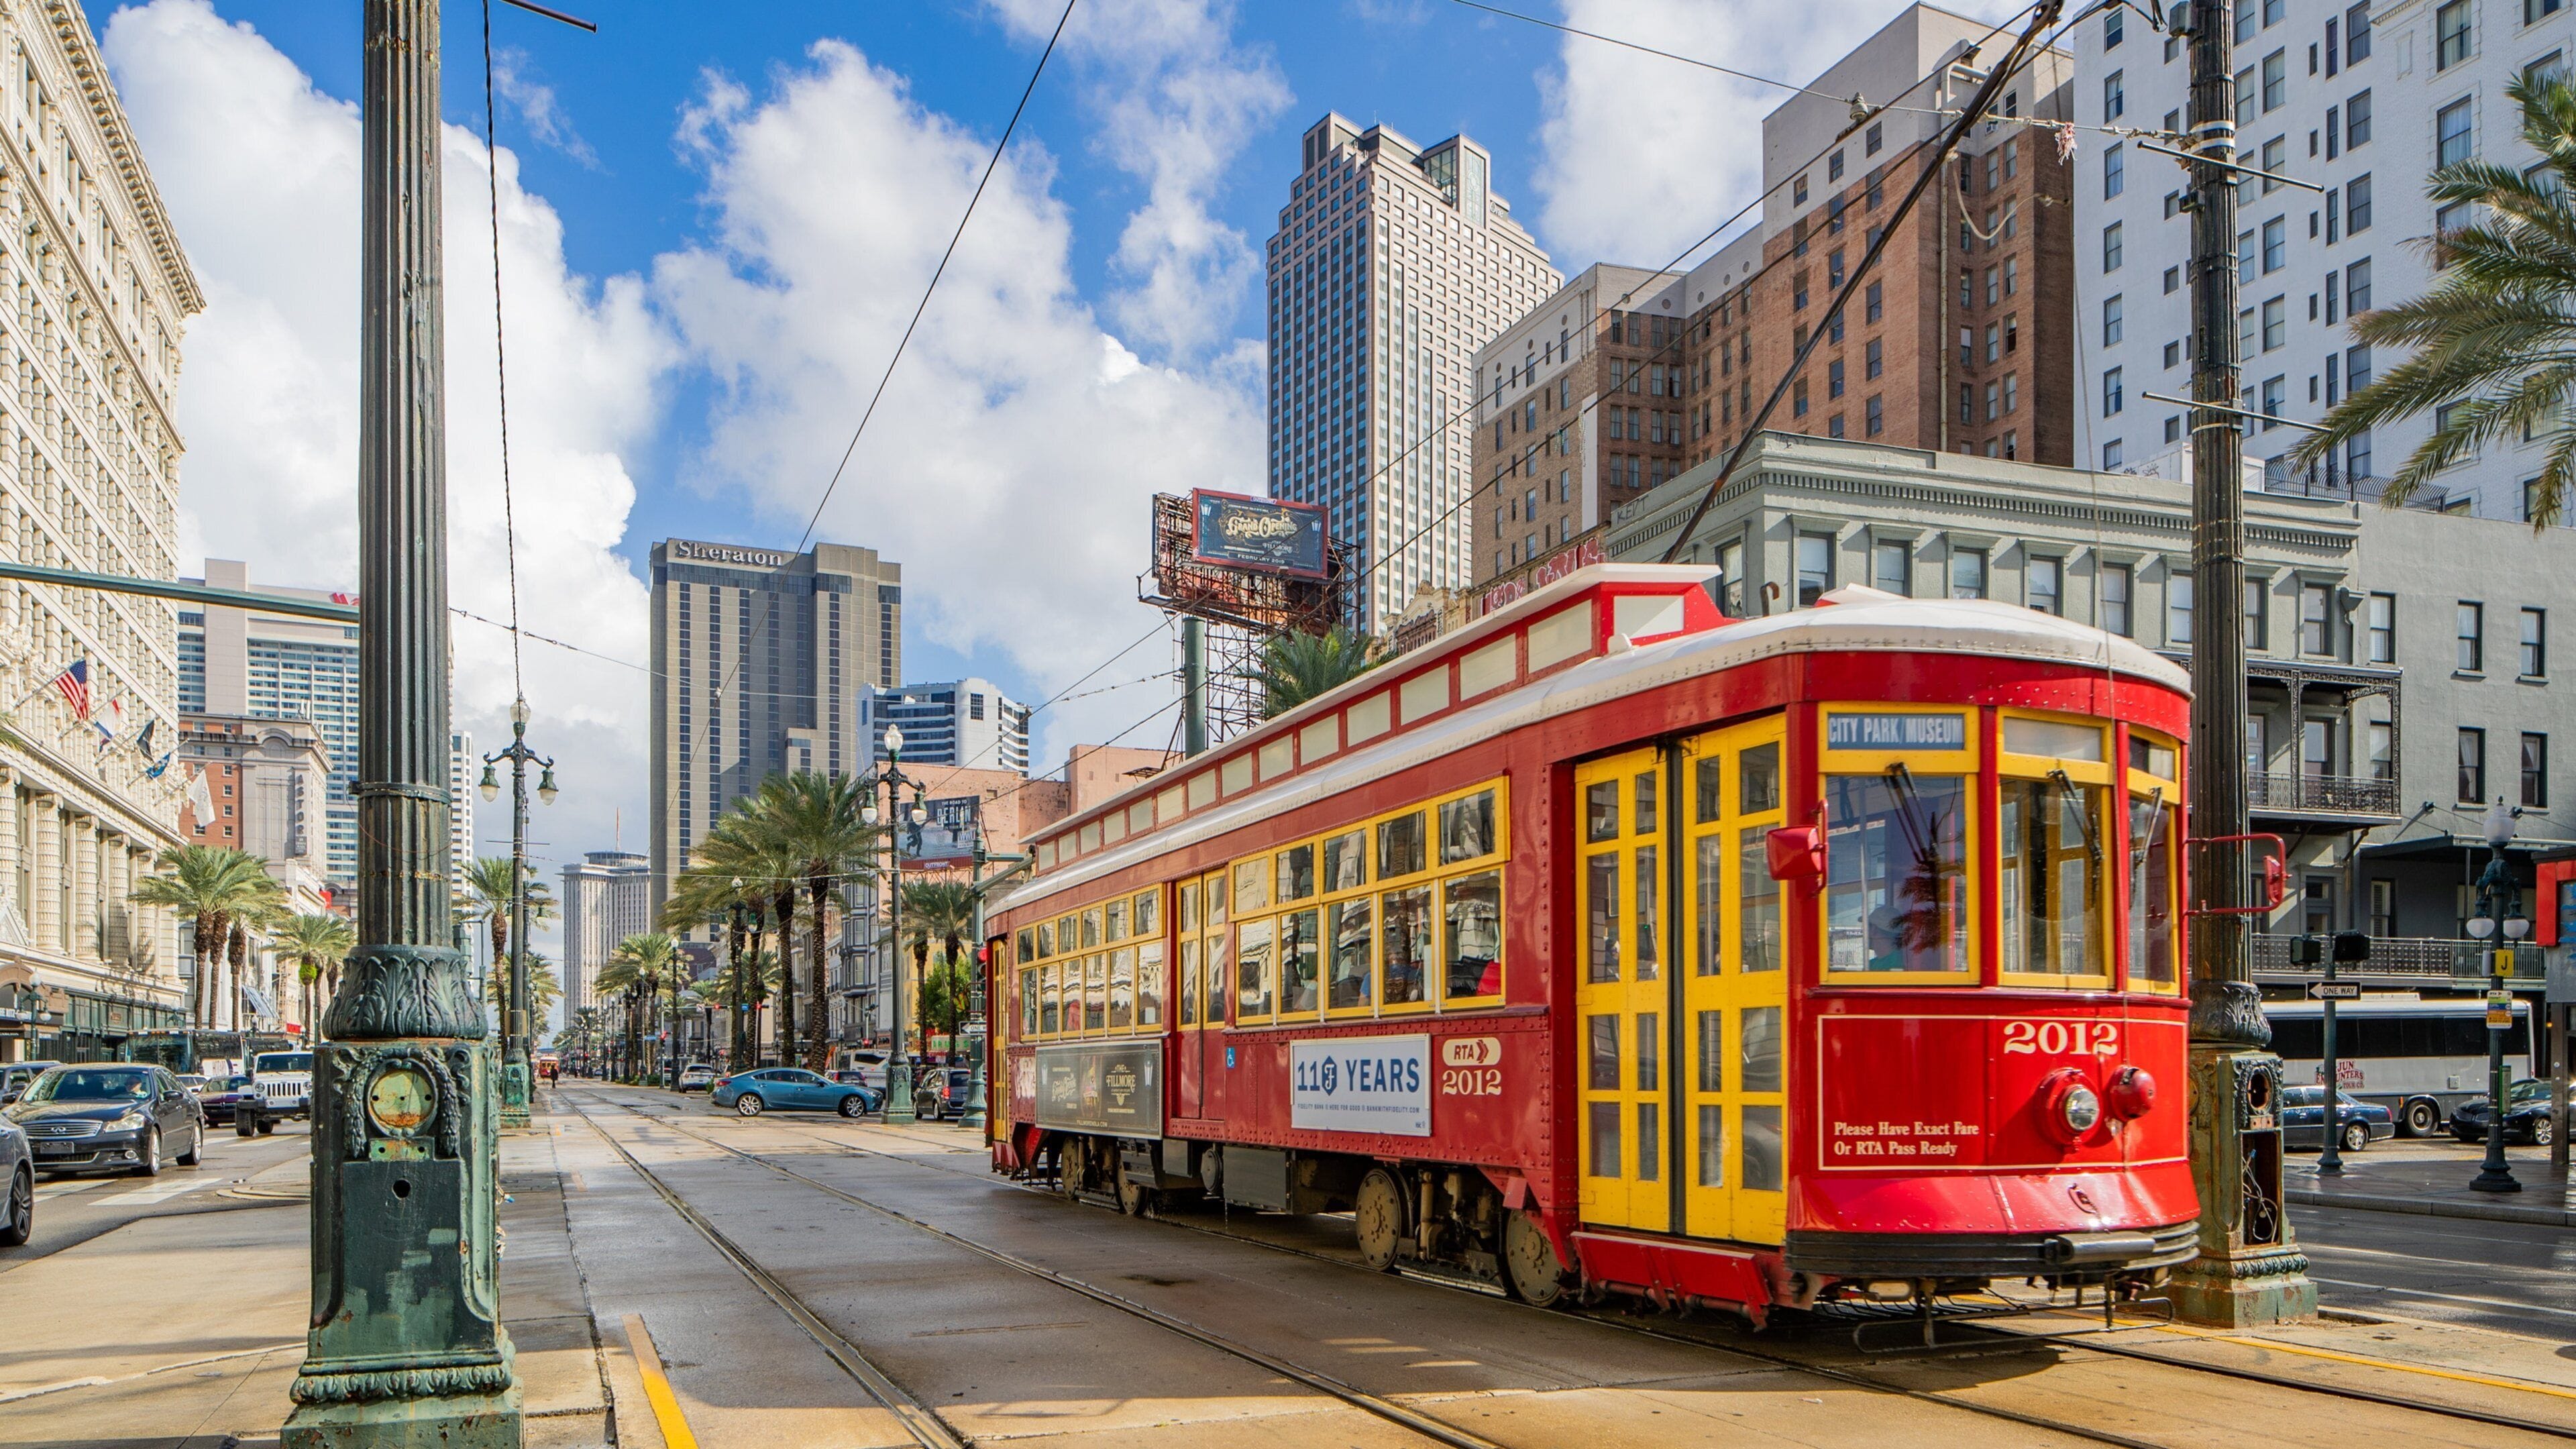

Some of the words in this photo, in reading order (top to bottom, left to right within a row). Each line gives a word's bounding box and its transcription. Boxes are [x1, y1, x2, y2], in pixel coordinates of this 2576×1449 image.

[678, 541, 782, 567] Sheraton
[1237, 553, 1270, 563] FEBRUARY
[1829, 716, 1858, 743] CITY
[295, 773, 305, 835] ASTOR
[936, 805, 971, 824] BERLN
[2501, 955, 2508, 970] J
[2323, 987, 2339, 995] ONE
[2340, 987, 2355, 995] WAY
[2003, 1021, 2118, 1055] 2012
[1454, 1044, 1474, 1060] RTA
[1106, 1075, 1136, 1093] FILLMORE
[1346, 1058, 1419, 1093] YEARS
[1442, 1069, 1502, 1095] 2012
[2316, 1070, 2364, 1085] ENUNTERS
[1833, 1122, 1874, 1136] Please
[1878, 1122, 1910, 1135] Have
[1914, 1122, 1950, 1135] Exact
[1953, 1121, 1980, 1135] Fare
[1833, 1141, 1851, 1155] Or
[1856, 1141, 1884, 1155] RTA
[1888, 1141, 1917, 1155] Pass
[1920, 1141, 1958, 1157] Ready
